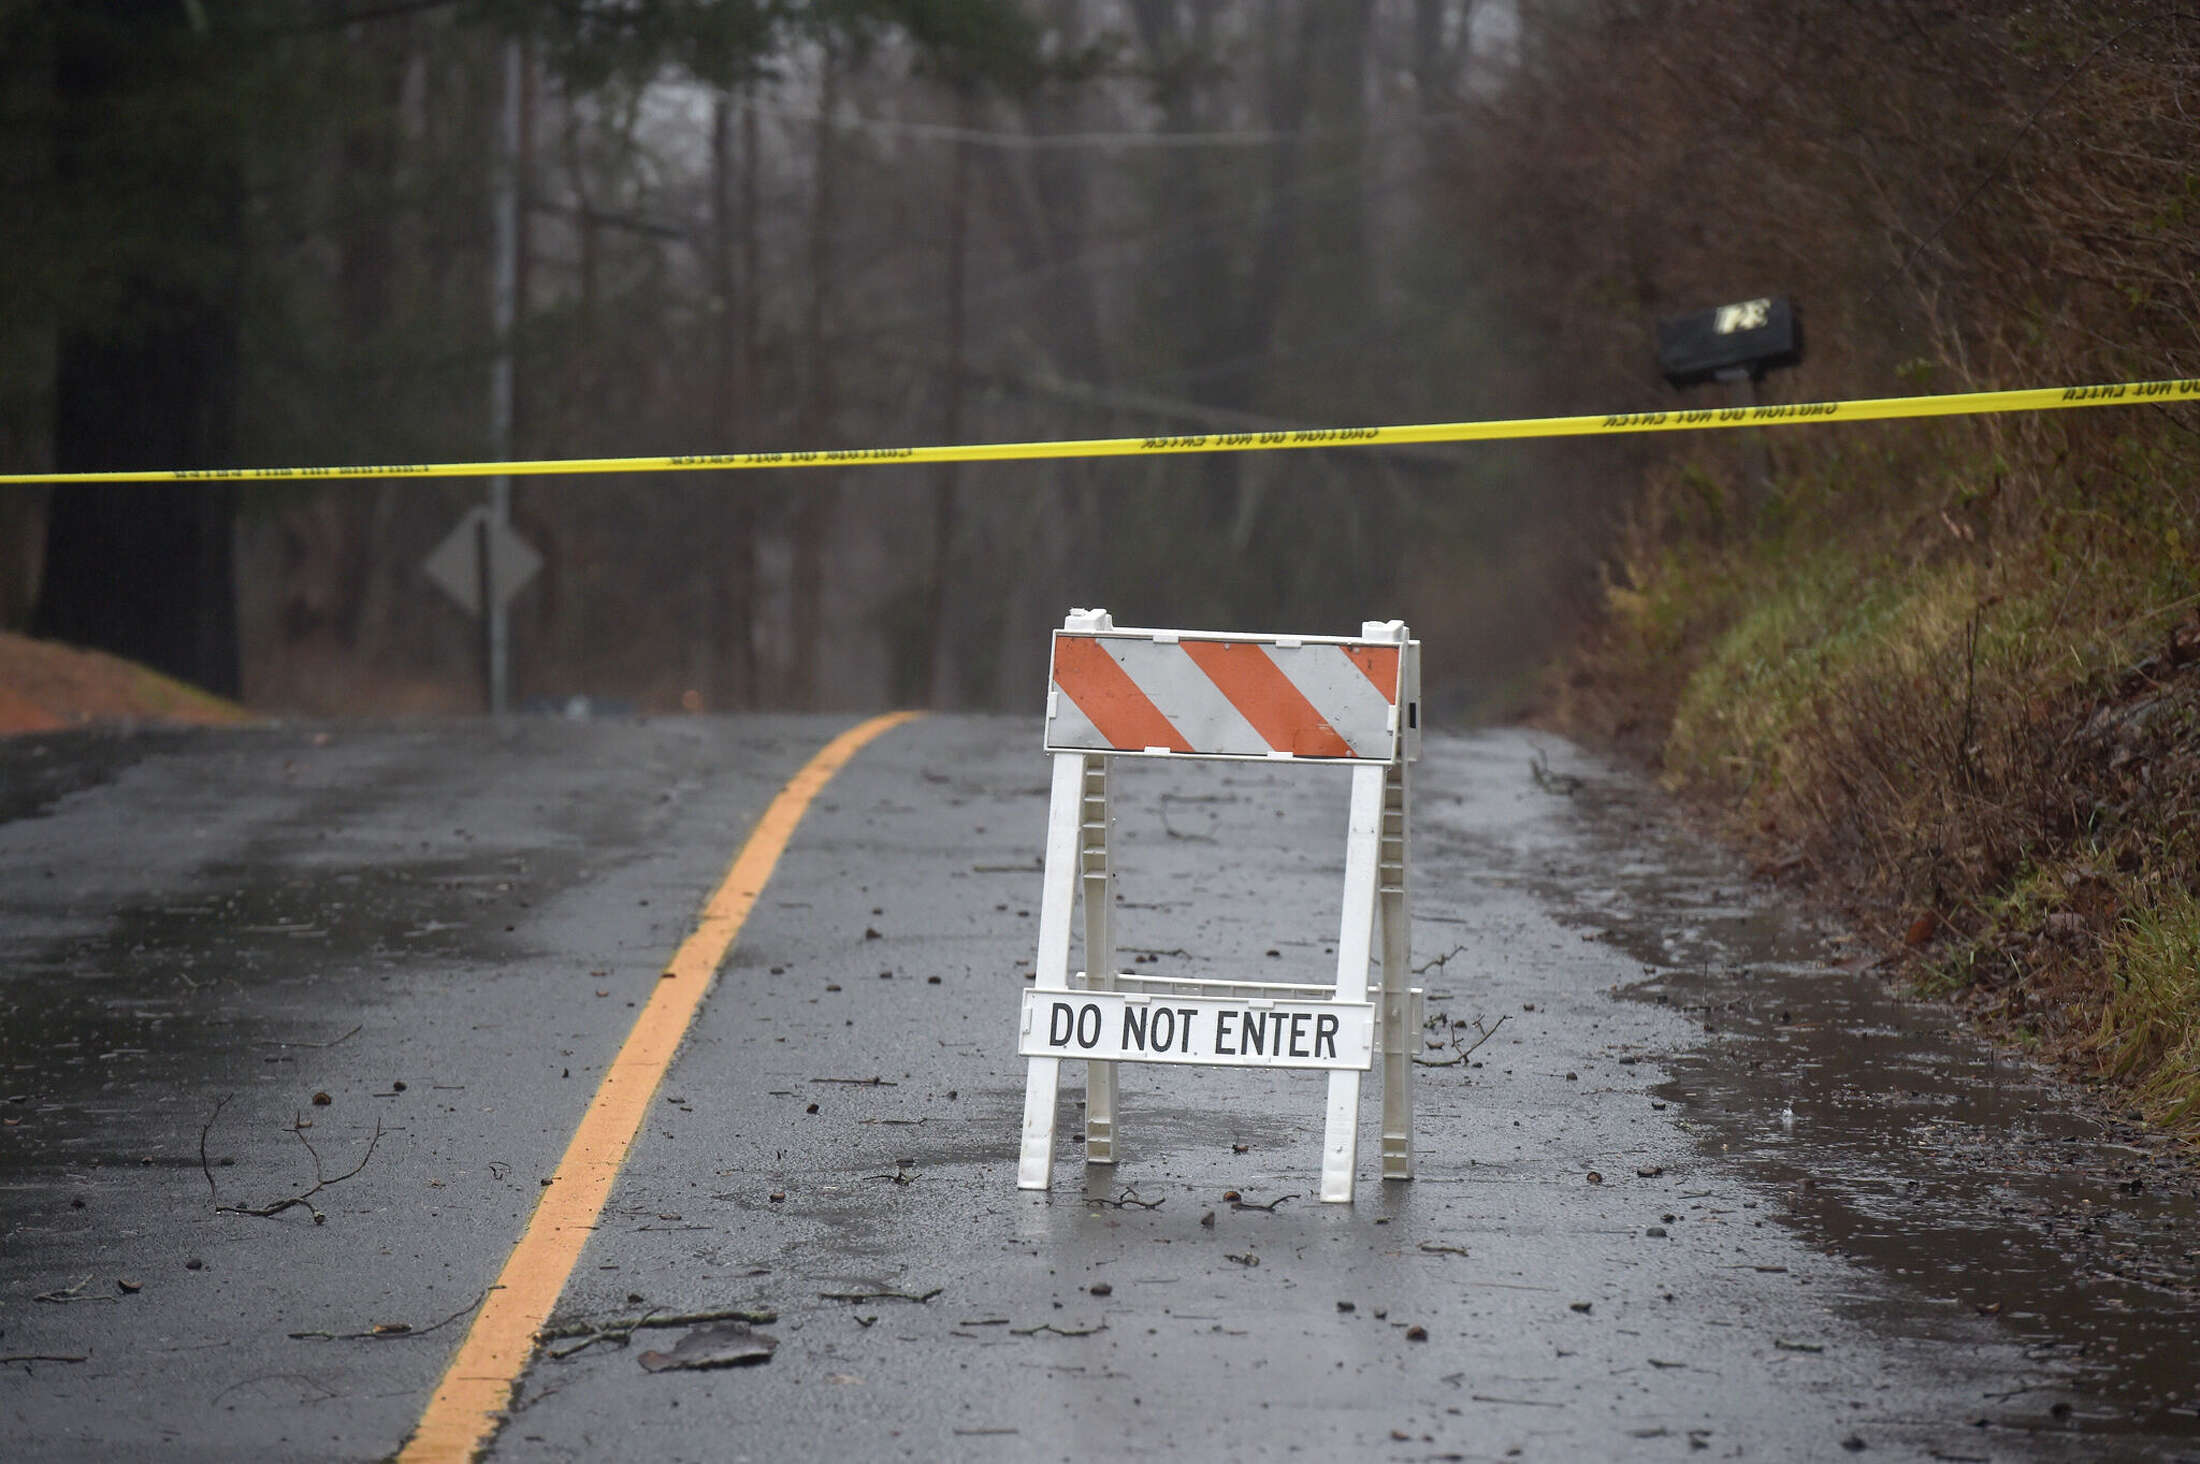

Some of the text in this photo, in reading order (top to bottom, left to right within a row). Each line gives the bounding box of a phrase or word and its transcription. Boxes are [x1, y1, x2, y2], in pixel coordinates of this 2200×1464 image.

[1049, 1002, 1340, 1059] DO NOT ENTER
